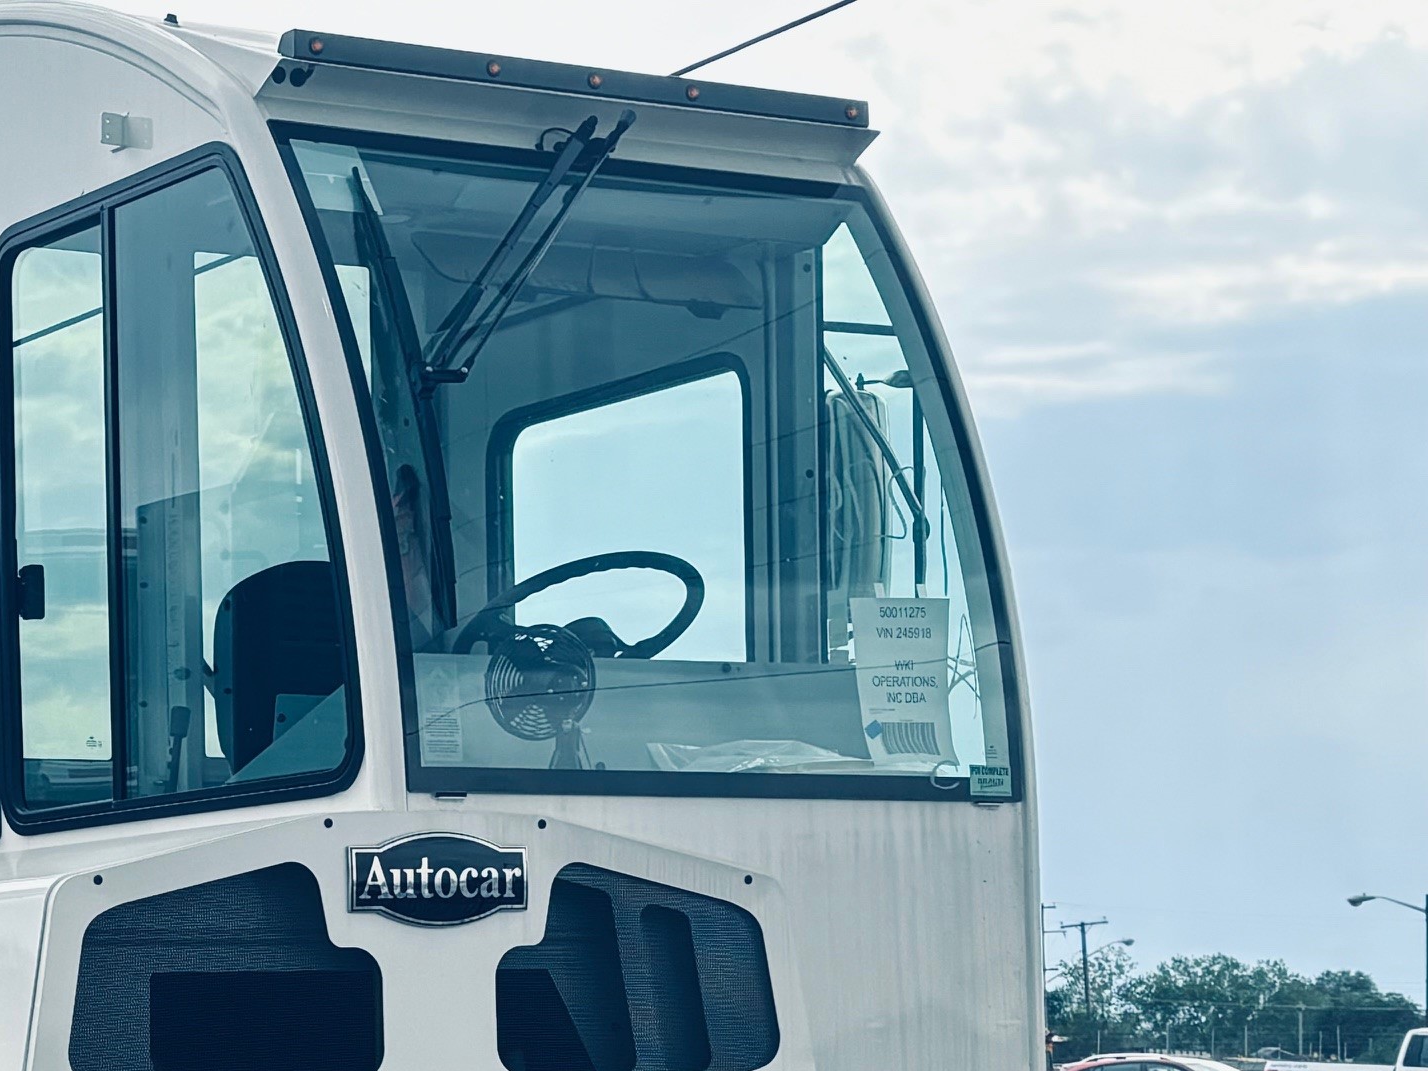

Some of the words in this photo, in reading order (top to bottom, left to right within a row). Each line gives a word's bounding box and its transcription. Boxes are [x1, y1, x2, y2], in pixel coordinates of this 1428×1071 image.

[879, 606, 927, 619] 50011275
[876, 627, 893, 639] VIN
[896, 627, 932, 639] 245918
[872, 675, 939, 689] OPERATIONS,
[886, 692, 902, 704] INC
[905, 692, 927, 704] DBA
[358, 854, 522, 900] Autocar
